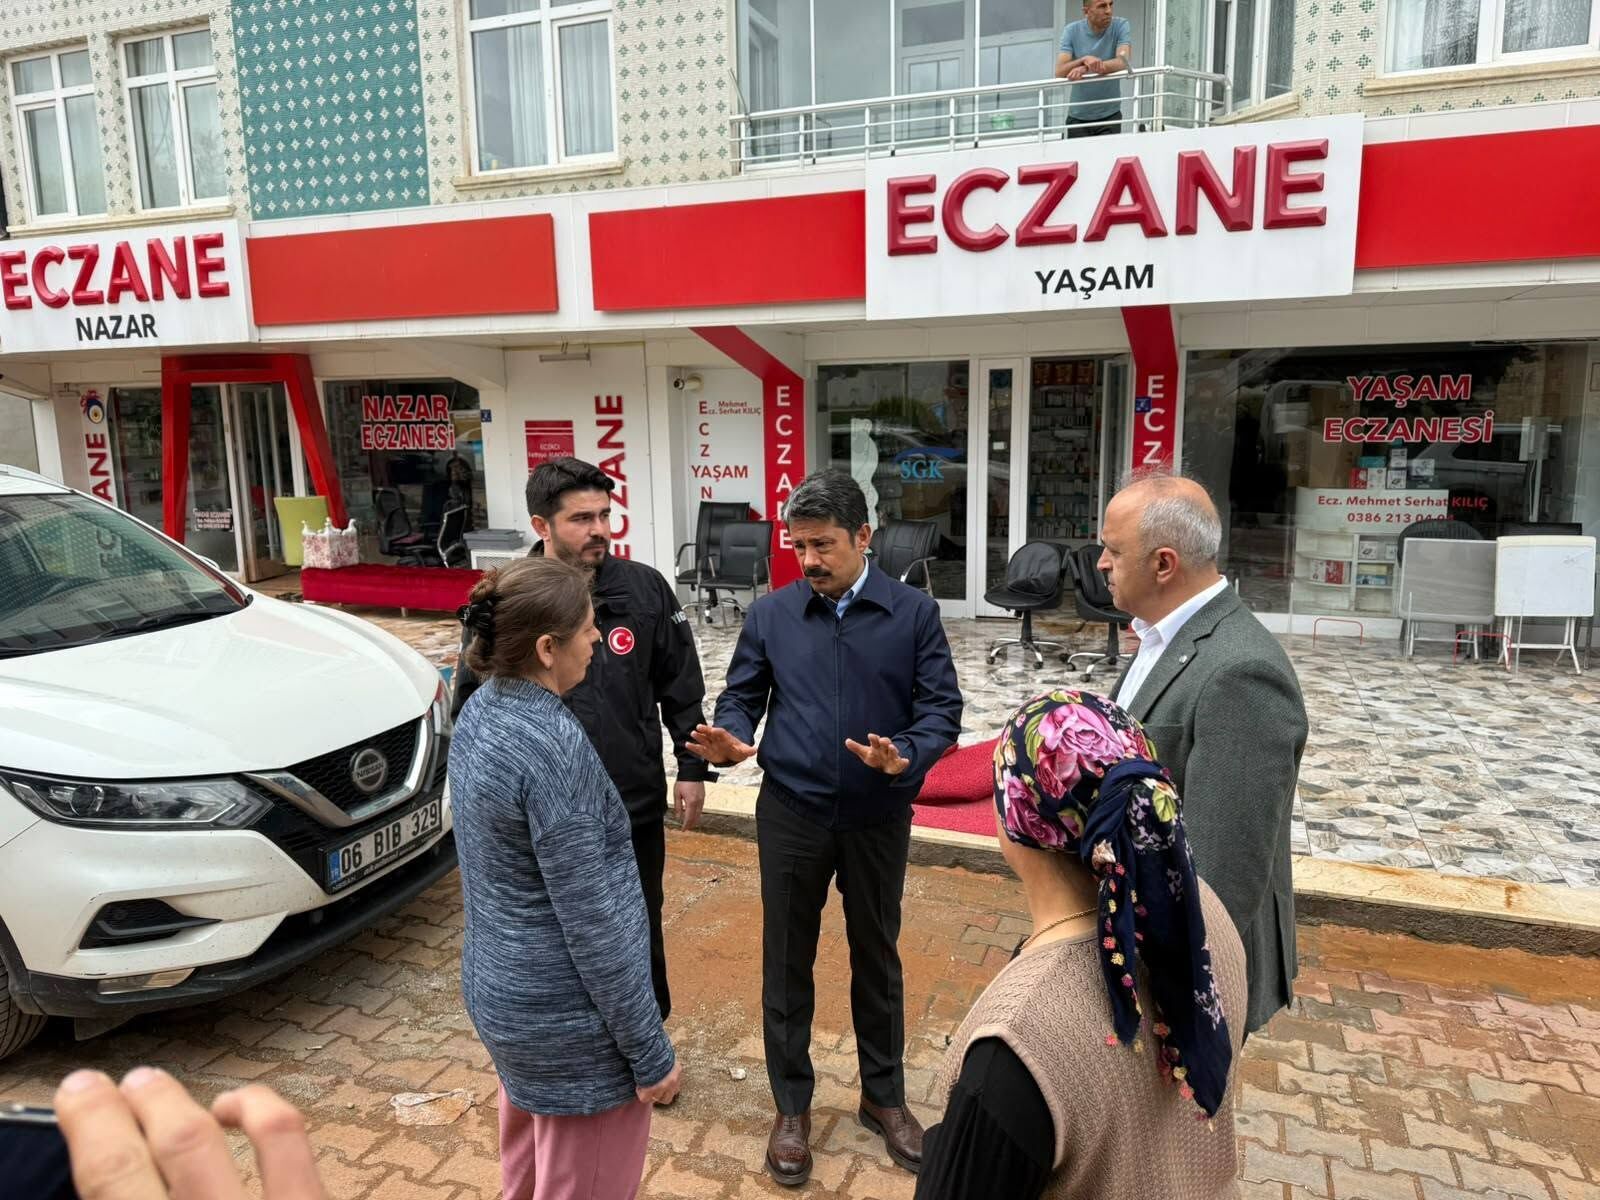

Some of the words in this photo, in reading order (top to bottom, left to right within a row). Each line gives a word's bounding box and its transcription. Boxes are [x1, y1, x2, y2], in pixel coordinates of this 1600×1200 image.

[887, 138, 1329, 257] ECZANE
[0, 233, 230, 310] ECZANE
[1035, 264, 1155, 300] YAŞAM
[75, 314, 159, 342] NAZAR
[1347, 374, 1472, 408] YAŞAM
[362, 395, 450, 422] NAZAR
[361, 424, 456, 450] ECZANESİ
[1323, 410, 1495, 443] ECZANESİ
[691, 465, 748, 482] YAŞAM
[900, 459, 945, 480] SGK
[1318, 495, 1343, 505] Ecz.
[1346, 495, 1401, 507] Mehmet
[1404, 496, 1448, 507] Serhat
[1452, 496, 1488, 509] KILIÇ
[1347, 512, 1381, 522] 0386
[1386, 513, 1411, 523] 213
[341, 842, 362, 874] 06
[374, 822, 401, 859] BIB
[411, 802, 438, 836] 329
